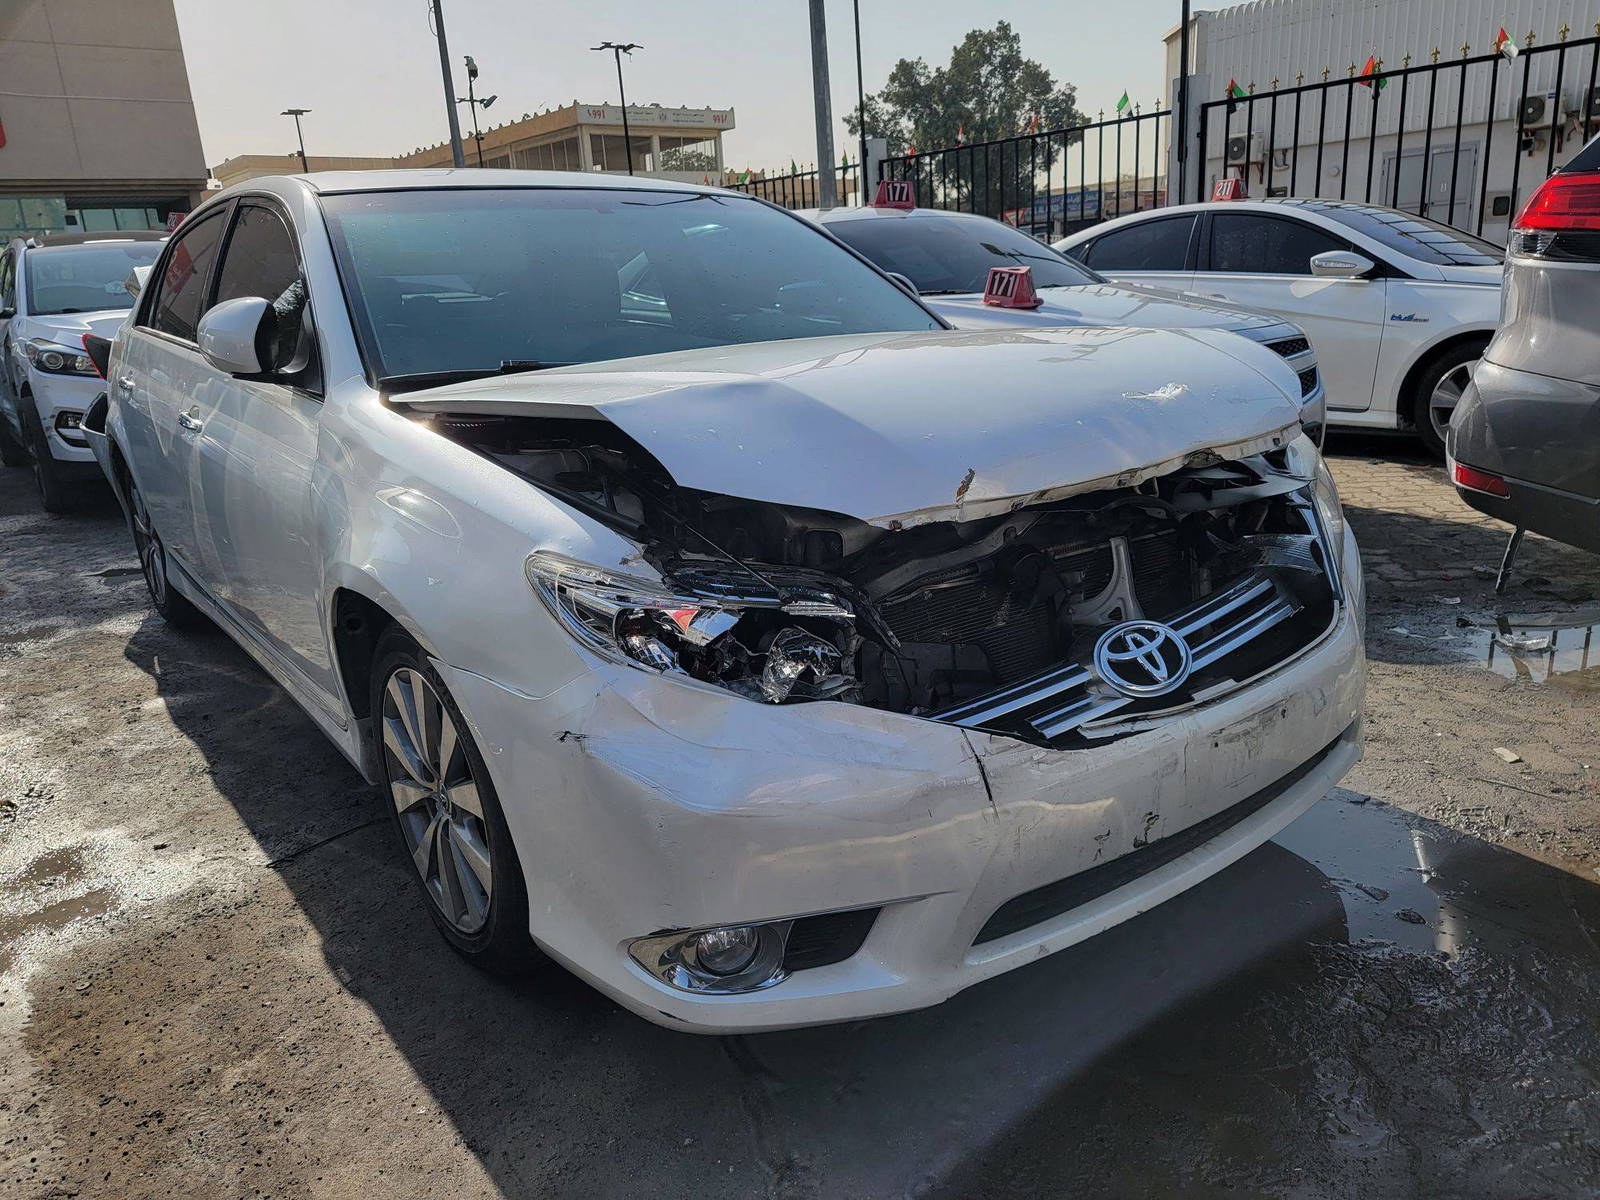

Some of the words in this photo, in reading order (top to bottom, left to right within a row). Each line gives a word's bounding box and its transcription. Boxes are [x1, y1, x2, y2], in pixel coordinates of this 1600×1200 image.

[887, 183, 908, 201] 177
[1216, 181, 1232, 196] 211
[992, 272, 1016, 297] 171
